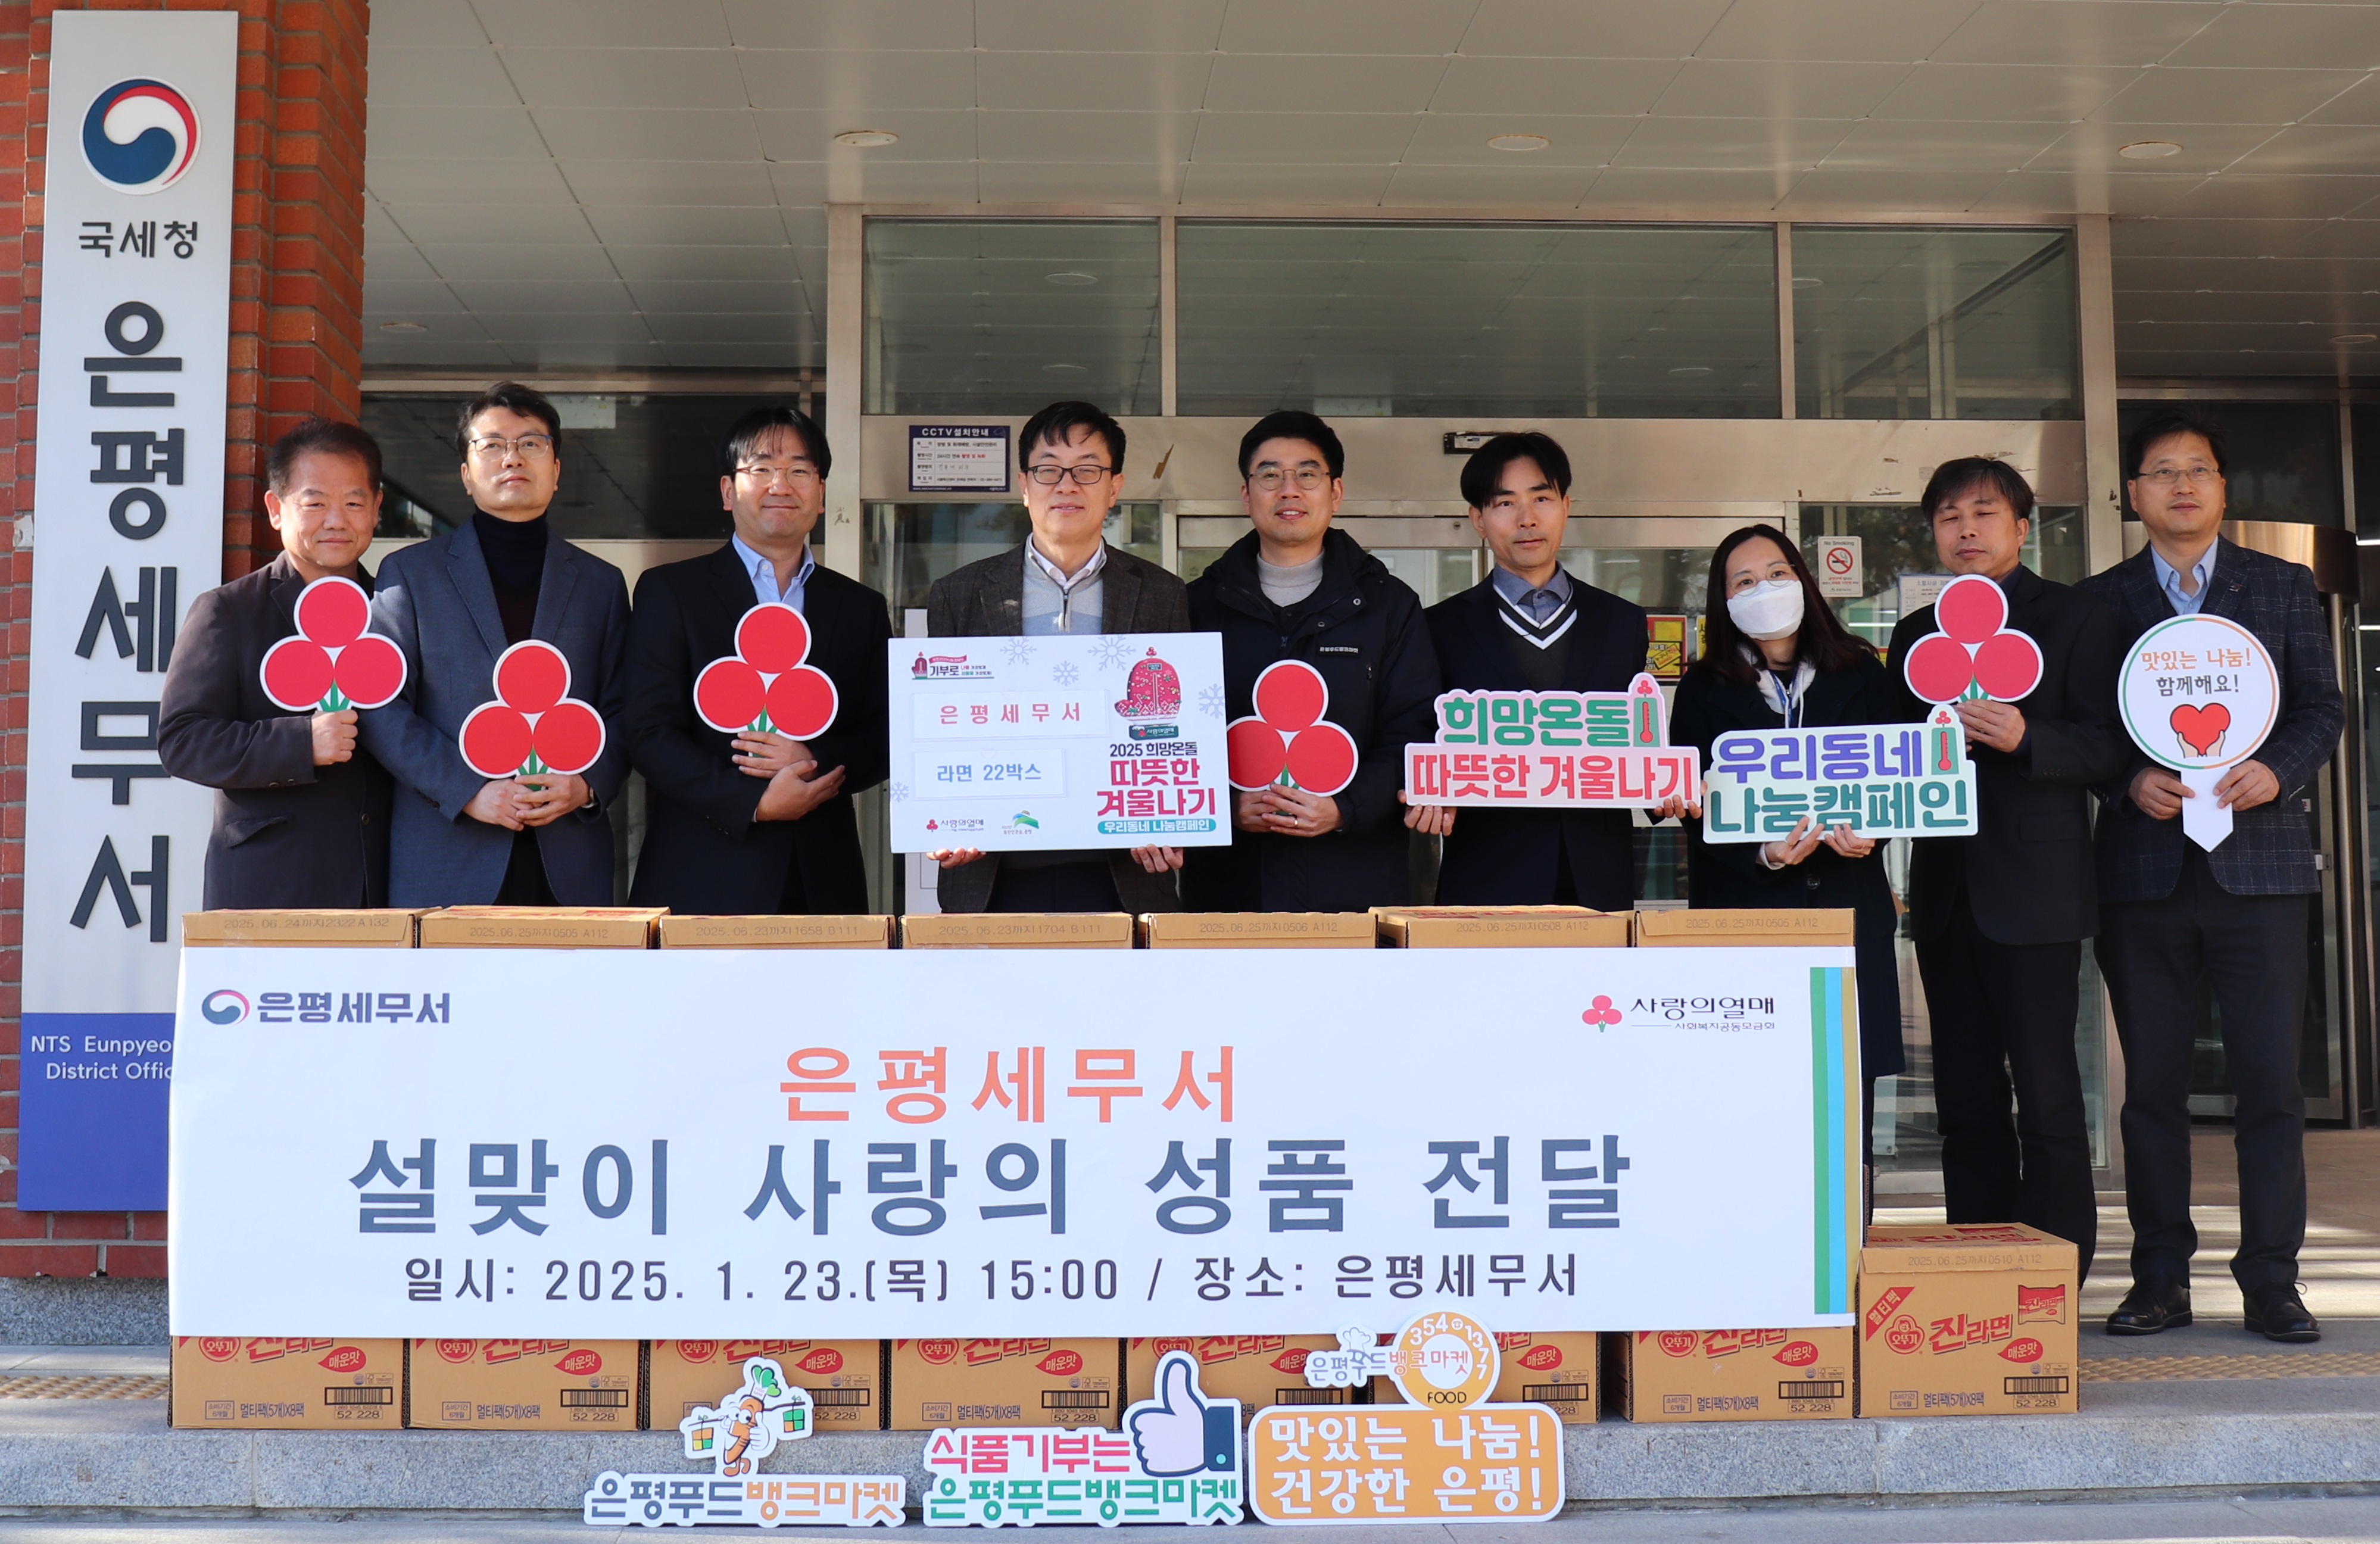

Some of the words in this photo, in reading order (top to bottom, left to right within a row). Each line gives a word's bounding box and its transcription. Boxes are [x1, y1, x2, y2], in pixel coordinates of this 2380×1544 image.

[79, 221, 198, 259] 국세청
[70, 301, 184, 943] 은평세무서
[2141, 651, 2197, 671] 맛있는
[2206, 648, 2251, 667] 나눔!
[929, 666, 959, 676] 기부로
[2156, 675, 2239, 696] 함께해요!
[939, 703, 1081, 724] 은평세무서
[1443, 698, 1629, 747] 희망온돌
[1109, 744, 1143, 757] 2025
[1146, 742, 1197, 756] 희망온돌
[1718, 730, 1923, 784] 우리동네
[937, 765, 972, 782] 라면
[983, 763, 1042, 781] 22박스
[1110, 757, 1200, 787] 따뜻한
[1412, 752, 1530, 798] 따뜻한
[1540, 754, 1692, 801] 겨울나기
[1096, 787, 1216, 817] 겨울나기
[1711, 779, 1968, 834] 나눔캠페인
[1104, 821, 1149, 832] 우리동네
[1153, 819, 1210, 832] 나눔캠페인
[257, 992, 450, 1024] 은평세무서
[1630, 997, 1774, 1020] 사랑의열매
[1674, 1022, 1775, 1032] 사회복지공동모금회
[30, 1036, 71, 1053] NTS
[85, 1035, 172, 1057] Eunpyeo
[46, 1062, 118, 1080] District
[126, 1062, 173, 1080] Offic
[779, 1046, 1234, 1124] 은평세무서
[349, 1138, 669, 1237] 설맞이
[743, 1138, 1066, 1237] 사랑의
[1144, 1138, 1353, 1235] 성품
[1421, 1134, 1630, 1228] 전달
[405, 1258, 514, 1302] 일시:
[545, 1260, 684, 1300] 2025.
[717, 1261, 754, 1300] 1.
[784, 1259, 947, 1302] 23.(목)
[981, 1259, 1118, 1299] 15:00
[1146, 1259, 1163, 1300] /
[1194, 1256, 1303, 1300] 장소:
[1335, 1253, 1575, 1298] 은평세무서
[1869, 1290, 1901, 1325] 멀티팩
[2026, 1297, 2057, 1309] 진라면
[1665, 1337, 1691, 1348] 오뚜기
[1892, 1334, 1917, 1345] 오뚜기
[1929, 1313, 2013, 1355] 진라면
[207, 1342, 233, 1353] 오뚜기
[443, 1342, 470, 1353] 오뚜기
[684, 1342, 710, 1353] 오뚜기
[925, 1343, 952, 1355] 오뚜기
[1410, 1313, 1448, 1345] 354
[1465, 1326, 1490, 1380] 1377
[1782, 1345, 1812, 1362] 매운맛
[2007, 1342, 2037, 1359] 매운맛
[329, 1350, 360, 1368] 매운맛
[565, 1353, 596, 1371] 매운맛
[806, 1352, 837, 1370] 매운맛
[1046, 1354, 1077, 1371] 매운맛
[1311, 1349, 1468, 1381] 은평푸드뱅크마켓
[1527, 1348, 1556, 1367] 매운맛
[1428, 1392, 1467, 1403] FOOD
[1054, 1414, 1069, 1422] 52
[1074, 1414, 1096, 1422] 228
[1269, 1417, 1407, 1462] 맛있는
[1432, 1415, 1539, 1460] 나눔!
[931, 1434, 1130, 1473] 식품기부는
[591, 1478, 899, 1521] 은평푸드뱅크마켓
[930, 1478, 1236, 1521] 은평푸드뱅크마켓
[1271, 1469, 1410, 1514] 건강한
[1434, 1467, 1542, 1513] 은평!
